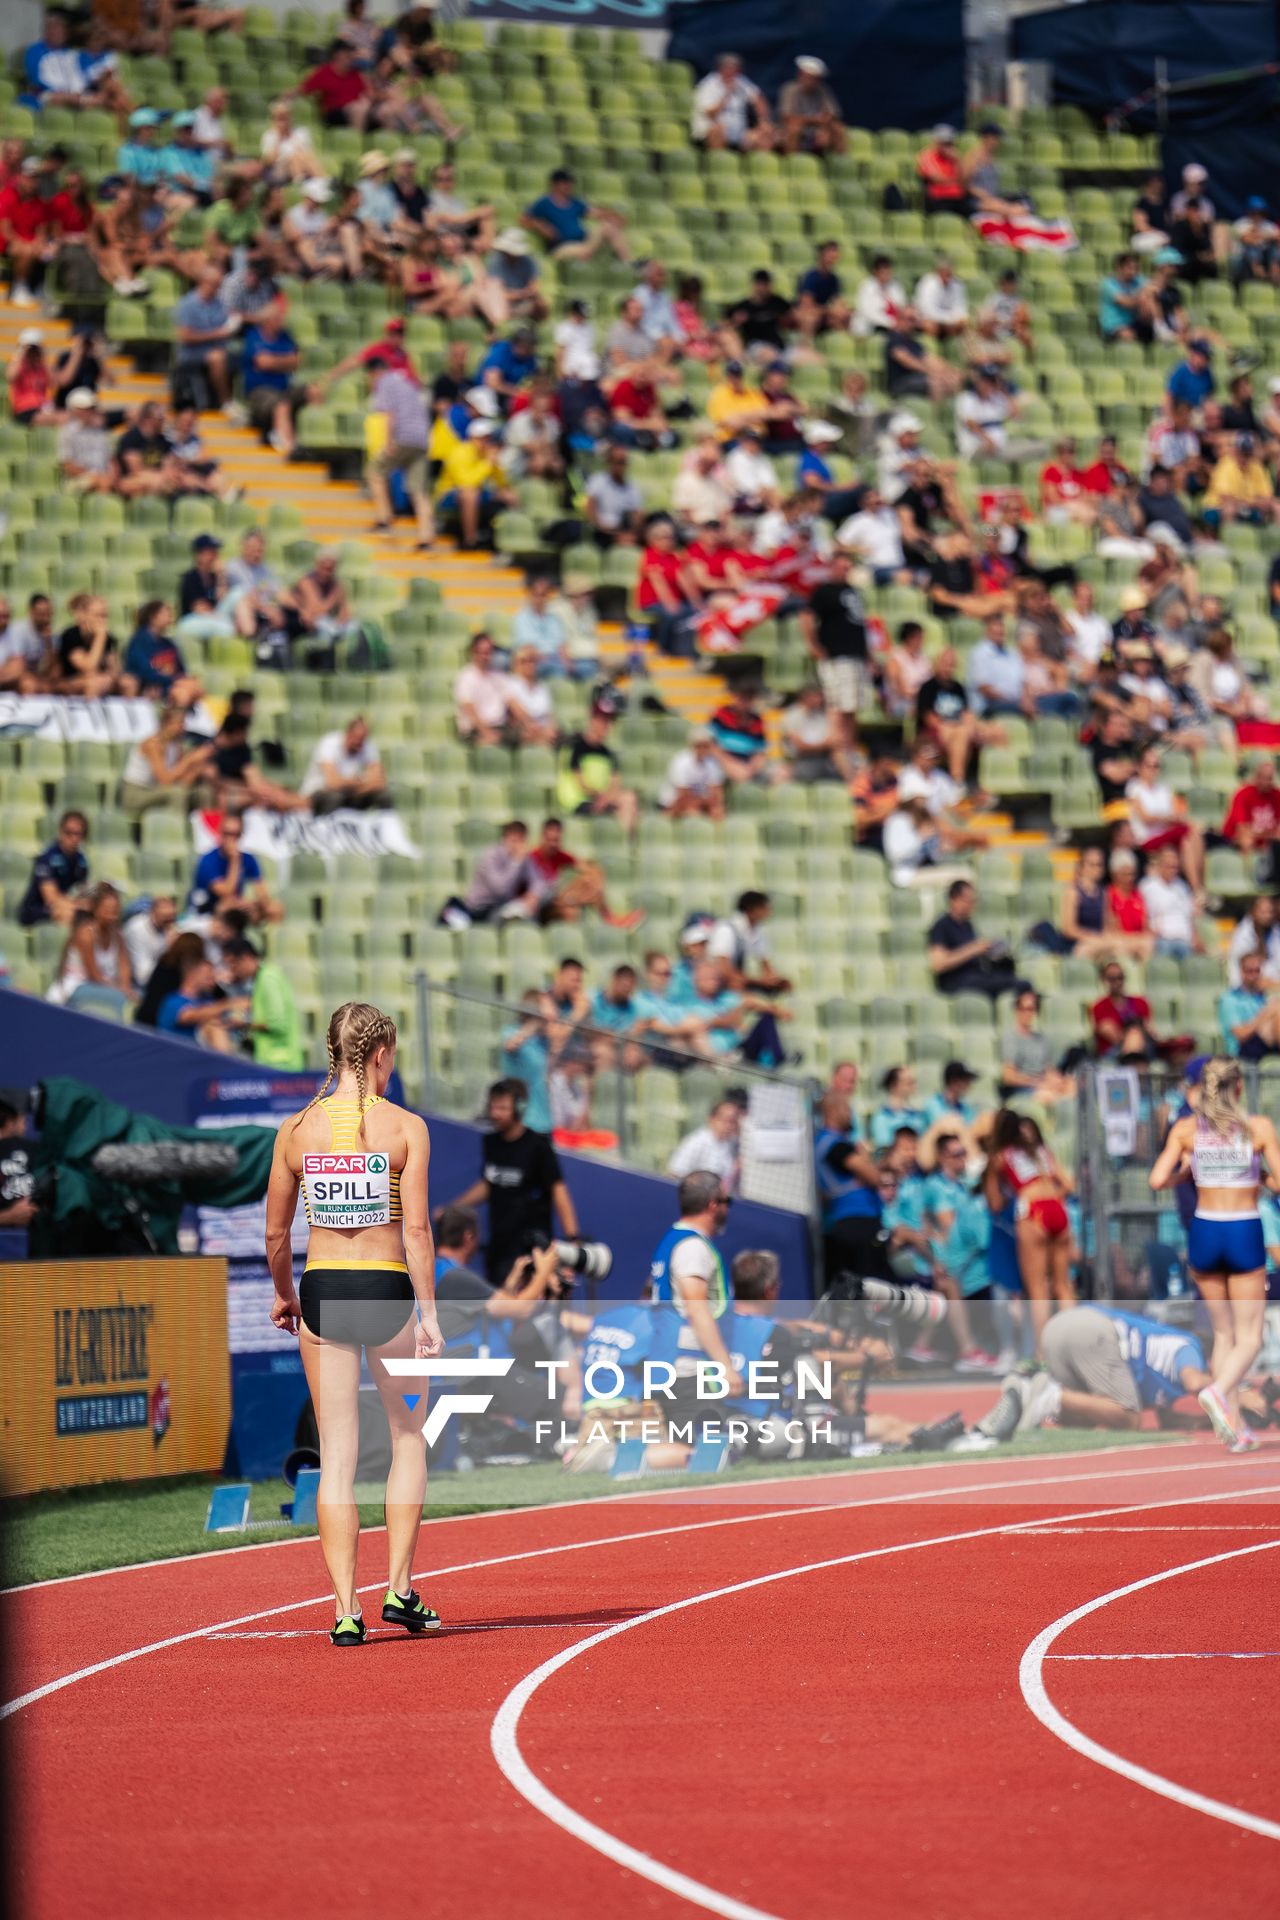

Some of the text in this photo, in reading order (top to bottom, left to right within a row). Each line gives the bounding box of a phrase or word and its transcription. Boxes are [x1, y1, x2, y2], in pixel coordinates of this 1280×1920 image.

[306, 1157, 364, 1172] SPAR
[313, 1181, 380, 1200] SPILL
[313, 1212, 385, 1225] MUNICH 2022
[58, 1396, 146, 1430] SWITZERLAND
